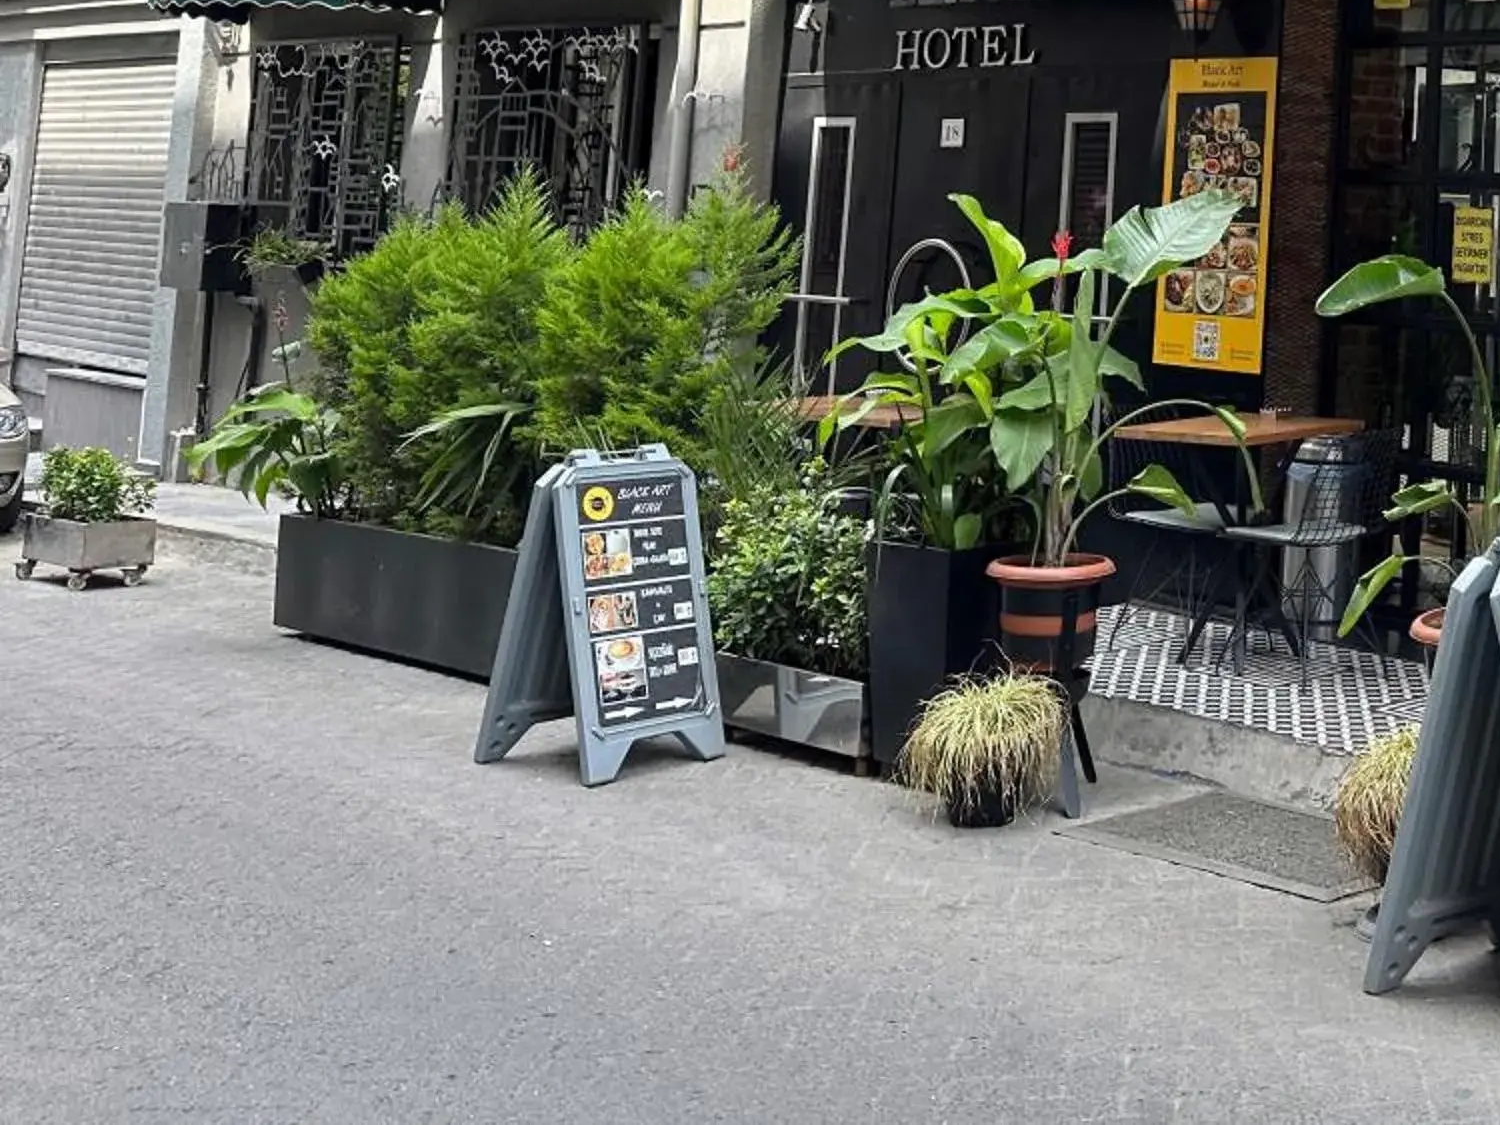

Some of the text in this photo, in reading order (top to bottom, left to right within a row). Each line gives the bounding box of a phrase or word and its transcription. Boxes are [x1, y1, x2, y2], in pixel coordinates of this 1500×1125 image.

[894, 22, 1036, 71] HOTEL
[943, 124, 961, 141] 18
[617, 483, 674, 500] BLACK ART
